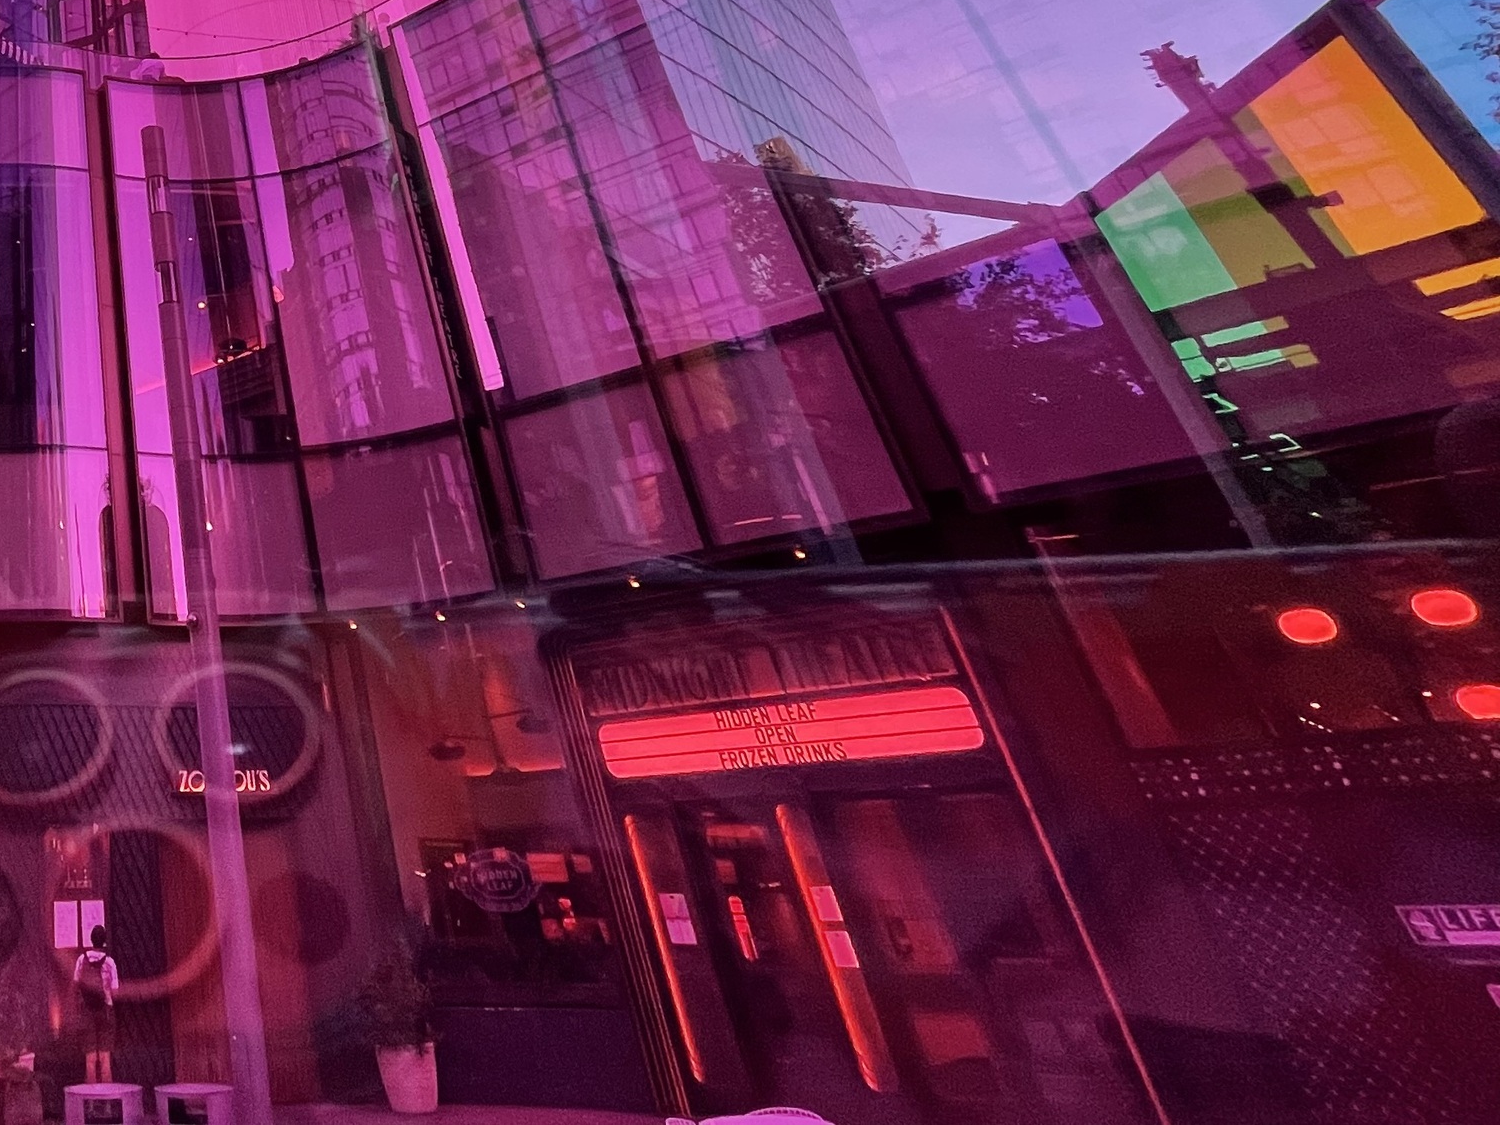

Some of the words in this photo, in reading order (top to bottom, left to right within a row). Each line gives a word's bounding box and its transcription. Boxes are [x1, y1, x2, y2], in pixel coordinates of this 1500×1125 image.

[713, 706, 772, 729] HIDDEN
[776, 702, 817, 722] LEAF
[754, 725, 798, 744] OPEN
[718, 747, 779, 770] FROZEN
[783, 742, 848, 765] DRINKS
[178, 769, 271, 792] ZOOU'S
